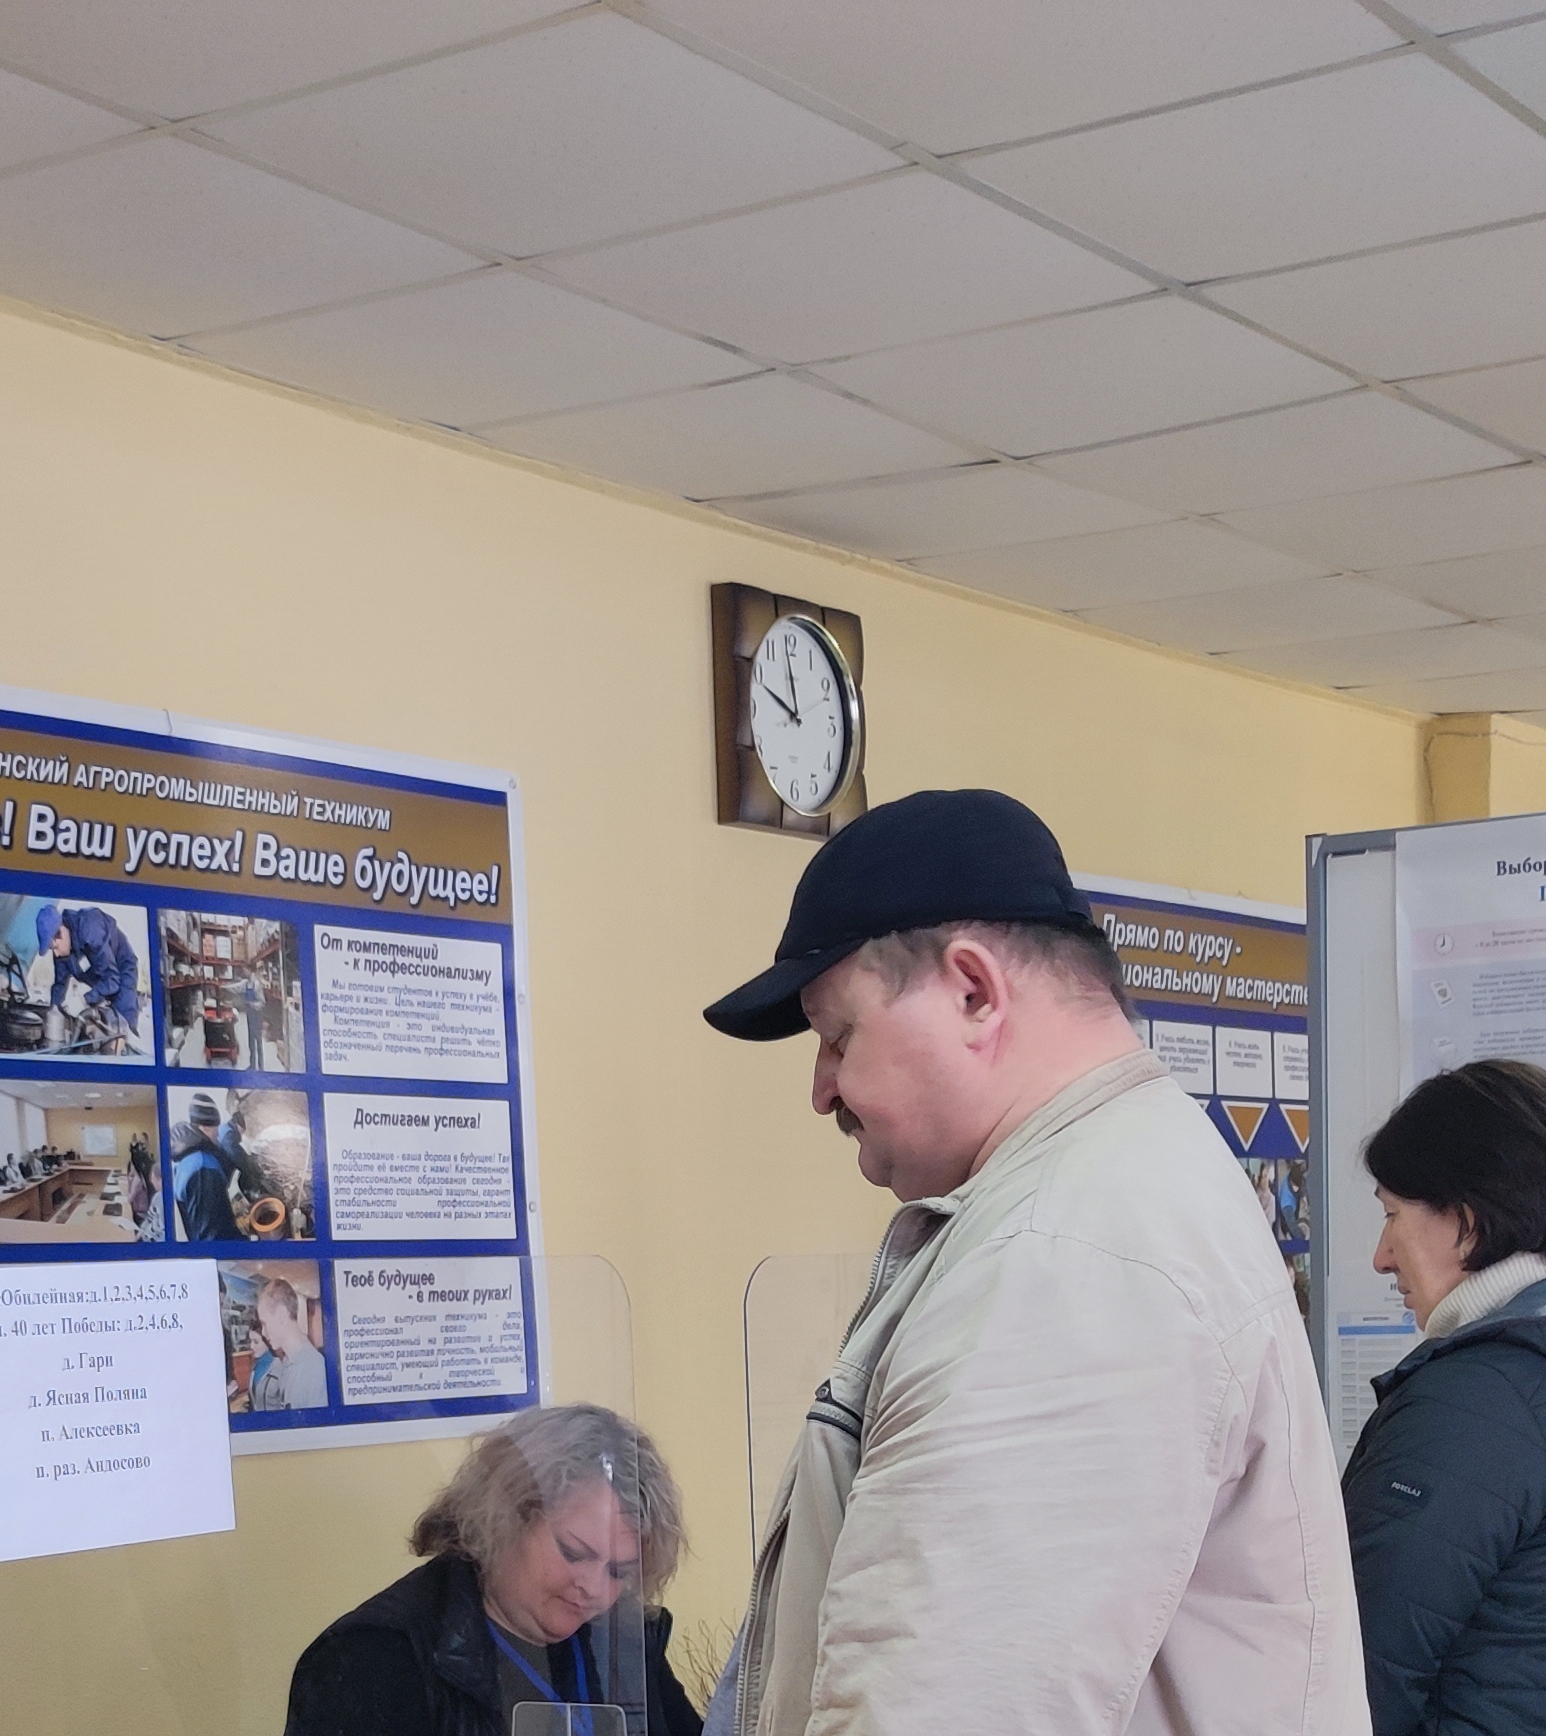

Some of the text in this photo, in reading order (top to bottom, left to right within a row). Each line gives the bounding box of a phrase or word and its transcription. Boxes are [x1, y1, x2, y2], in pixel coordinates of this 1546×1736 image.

[820, 677, 831, 702] 2
[827, 715, 837, 739] 3
[822, 751, 832, 774] 4
[789, 778, 800, 803] 6
[809, 773, 819, 796] 5
[73, 763, 300, 818] АГРОПРОМЫШЛЕННЫЙ
[303, 796, 392, 832] ТЕХНИКУМ
[26, 803, 116, 858] Ваш
[124, 826, 244, 874] успех!
[253, 833, 346, 886] Ваше
[353, 846, 501, 908] будущее!
[320, 932, 439, 962] От компетенций
[1103, 913, 1160, 952] Прямо
[1163, 928, 1185, 953] по
[1188, 931, 1234, 967] курсу
[353, 959, 360, 971] к
[364, 958, 492, 986] профессионализму
[353, 1107, 482, 1132] Достигаем успеха!
[333, 1174, 412, 1186] профессиональное
[396, 1186, 443, 1199] социальной
[343, 1269, 436, 1291] Твоё будущее
[417, 1290, 424, 1303] в
[428, 1289, 469, 1303] твоих
[472, 1284, 513, 1306] руках!
[11, 1319, 28, 1338] 40
[31, 1322, 57, 1336] лет
[61, 1317, 121, 1335] Победы:
[62, 1352, 114, 1373] д. Гари
[28, 1385, 148, 1409] д. Ясная Поляна
[41, 1421, 141, 1443] п. Алексеевка
[36, 1454, 151, 1482] п. раз. Андосово
